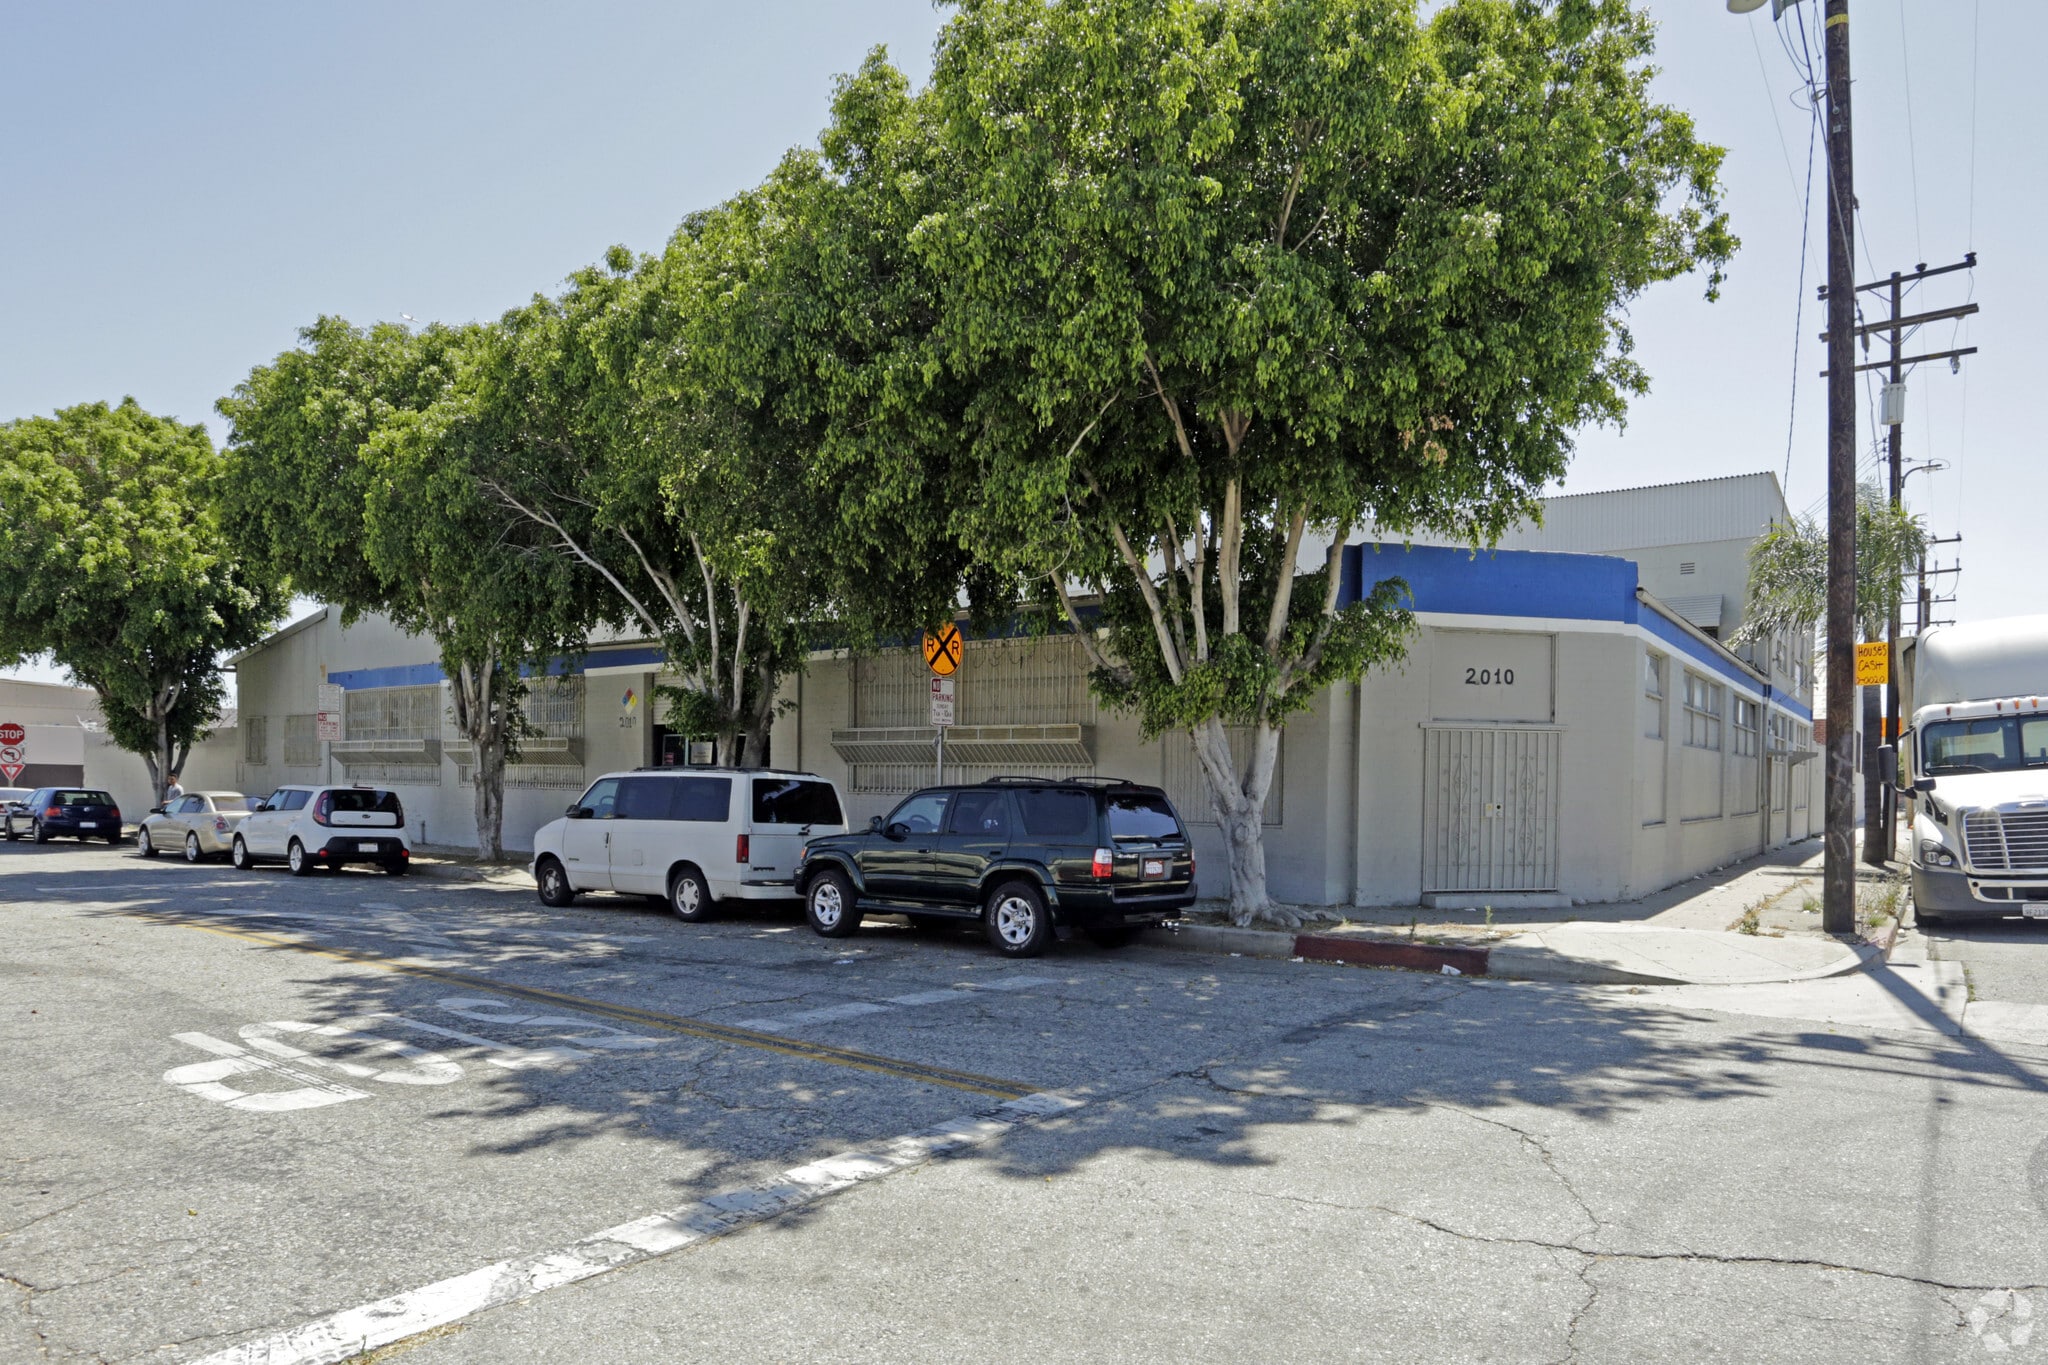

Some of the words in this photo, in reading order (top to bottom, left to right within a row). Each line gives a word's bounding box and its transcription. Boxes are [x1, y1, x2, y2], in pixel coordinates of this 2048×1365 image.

[1858, 660, 1884, 672] CASH
[1465, 667, 1514, 686] 2010
[932, 680, 941, 691] NO
[932, 693, 953, 703] PARKING
[318, 713, 327, 721] NO
[0, 730, 24, 739] STOP
